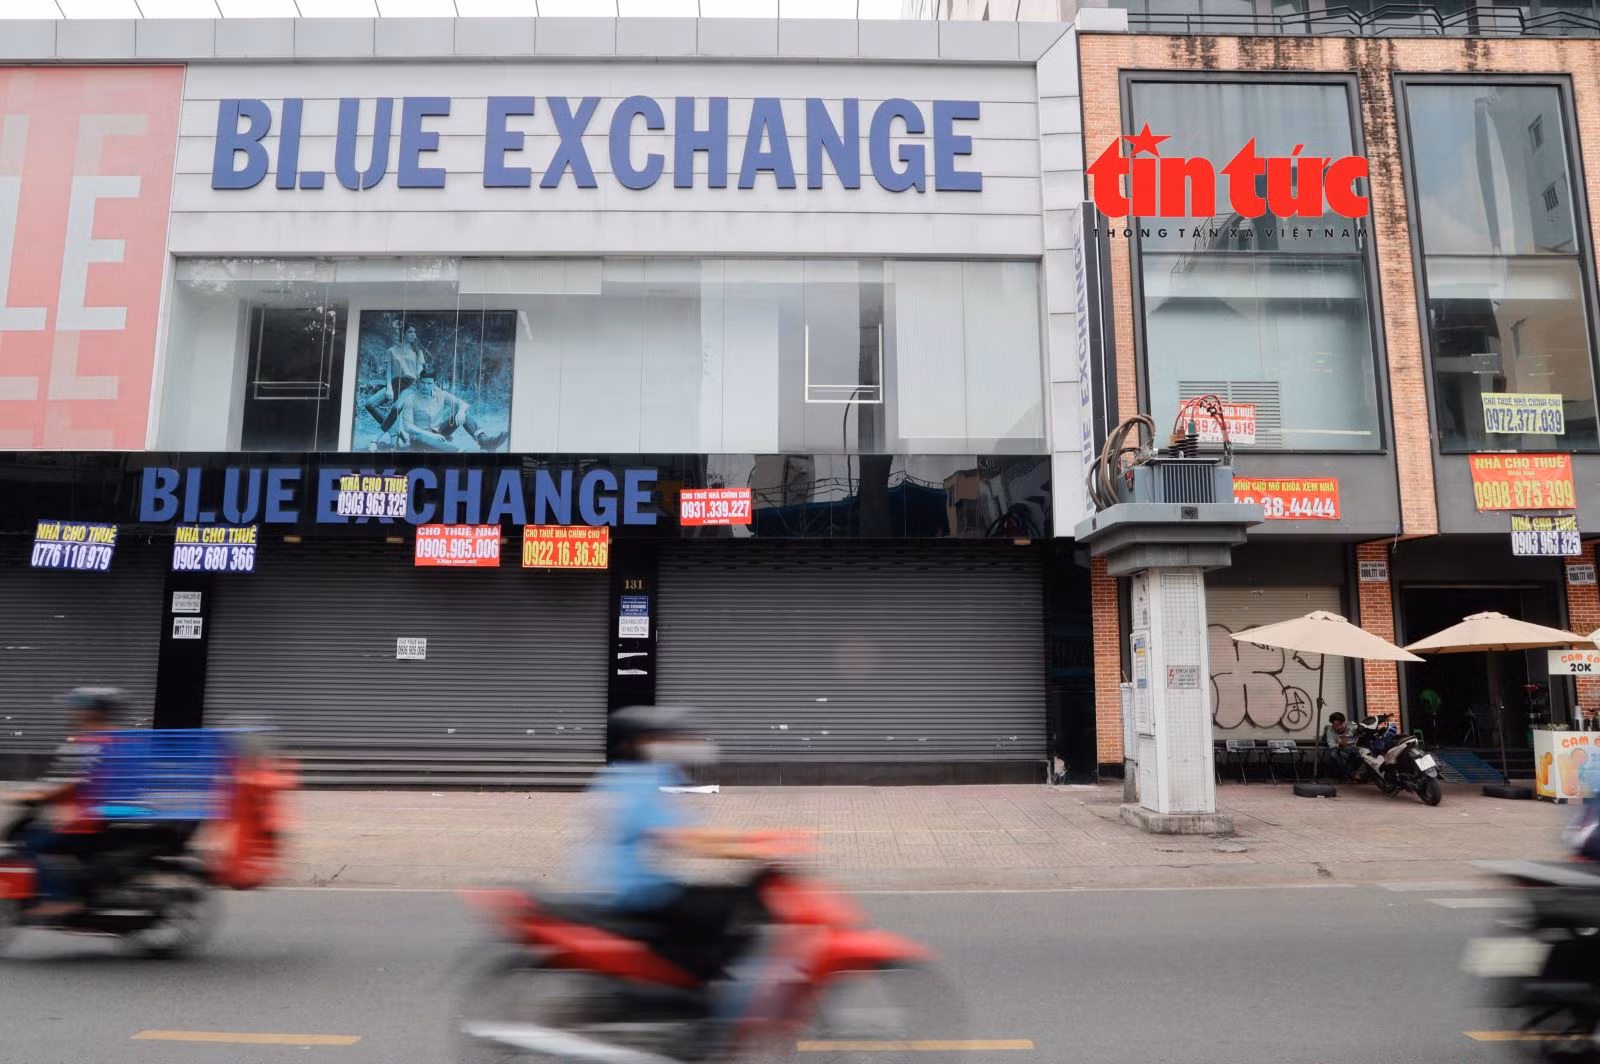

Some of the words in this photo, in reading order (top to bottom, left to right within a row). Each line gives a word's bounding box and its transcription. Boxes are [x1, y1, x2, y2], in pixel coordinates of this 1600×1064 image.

[211, 96, 450, 191] BLUE
[483, 95, 983, 193] EXCHANGE
[1486, 408, 1562, 432] 0972.377.039
[1475, 456, 1501, 469] NHÀ
[1504, 457, 1530, 468] CHO
[1534, 455, 1564, 468] THUÊ
[341, 474, 360, 491] NHÀ
[362, 477, 382, 492] CHO
[384, 476, 408, 493] THUÊ
[139, 467, 301, 524] BLUE
[1474, 481, 1510, 508] 0908
[1514, 480, 1543, 507] 875
[1546, 479, 1573, 507] 399
[338, 492, 365, 515] 0903
[366, 492, 386, 515] 963
[386, 493, 407, 516] 325
[681, 500, 750, 518] 0931.339.227
[36, 521, 60, 540] NHÀ
[62, 525, 86, 541] CHO
[88, 524, 117, 543] THUÊ
[175, 524, 199, 543] NHÀ
[201, 527, 225, 543] CHO
[229, 524, 257, 543] THUÊ
[417, 527, 441, 536] CHO
[525, 529, 538, 538] CHO
[539, 527, 554, 538] THUÊ
[1532, 517, 1553, 531] CHO
[416, 538, 499, 558] 0906.905.006
[1512, 532, 1538, 554] 0903
[1540, 532, 1559, 554] 963
[1561, 532, 1581, 554] 325
[31, 543, 62, 567] 0776
[63, 544, 87, 568] 110
[86, 546, 112, 570] 979
[173, 546, 203, 570] 0902
[204, 546, 228, 570] 680
[229, 546, 254, 571] 366
[525, 540, 607, 566] 0922.16.36.36
[624, 579, 642, 589] 131
[1561, 654, 1584, 663] CAM
[1570, 663, 1592, 672] 20K
[1562, 736, 1589, 748] CAM
